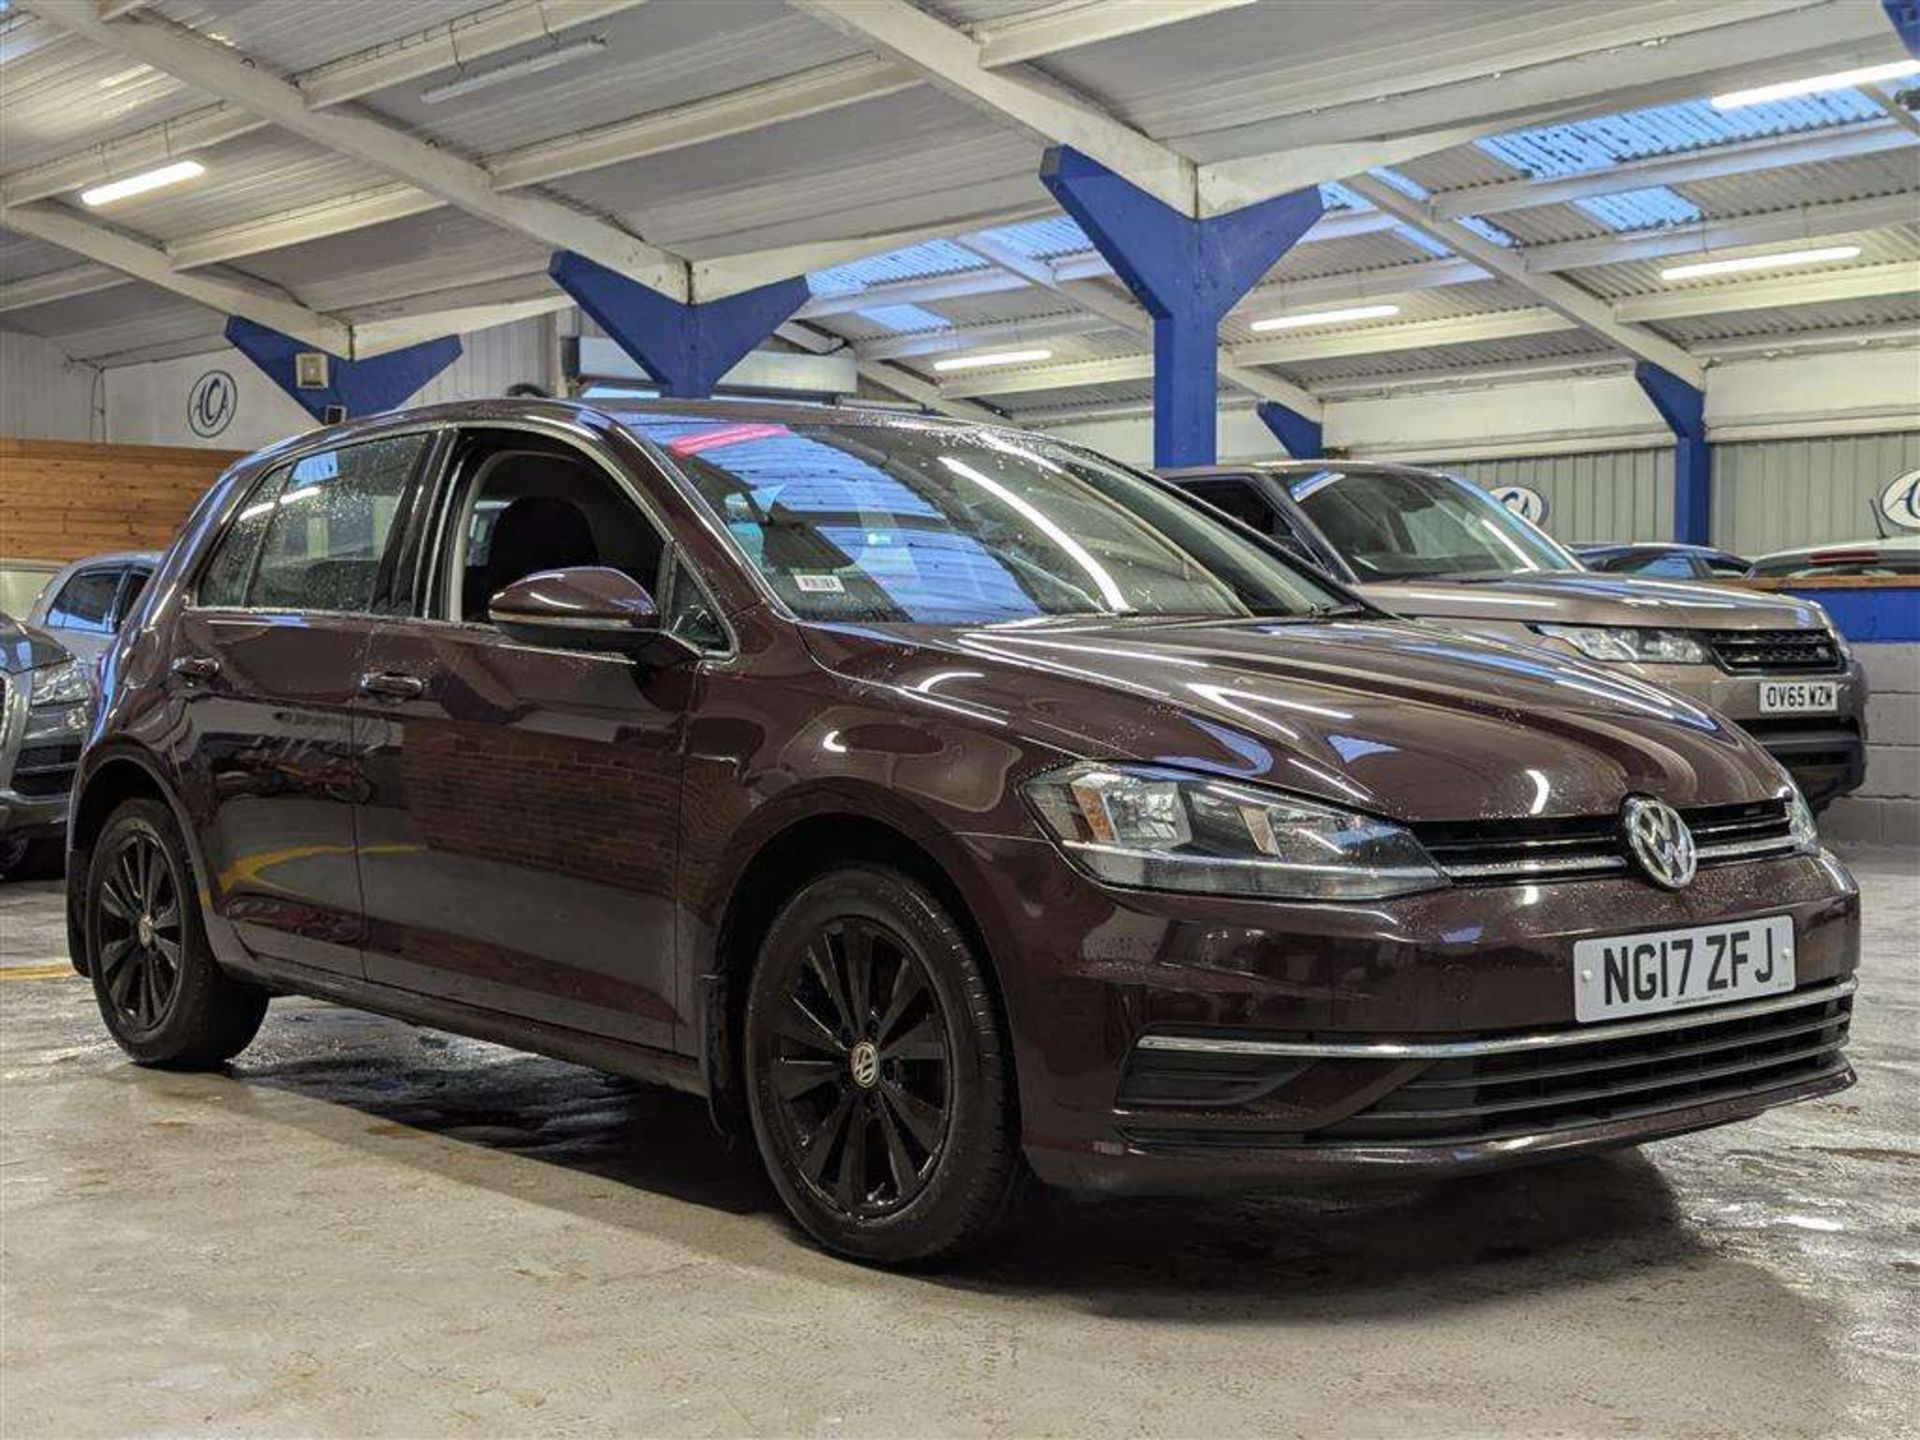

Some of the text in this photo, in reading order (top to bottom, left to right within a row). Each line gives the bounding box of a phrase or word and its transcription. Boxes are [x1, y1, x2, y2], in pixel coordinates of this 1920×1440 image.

[1767, 686, 1805, 707] OV65
[1603, 928, 1773, 1005] NG17 ZFJ
